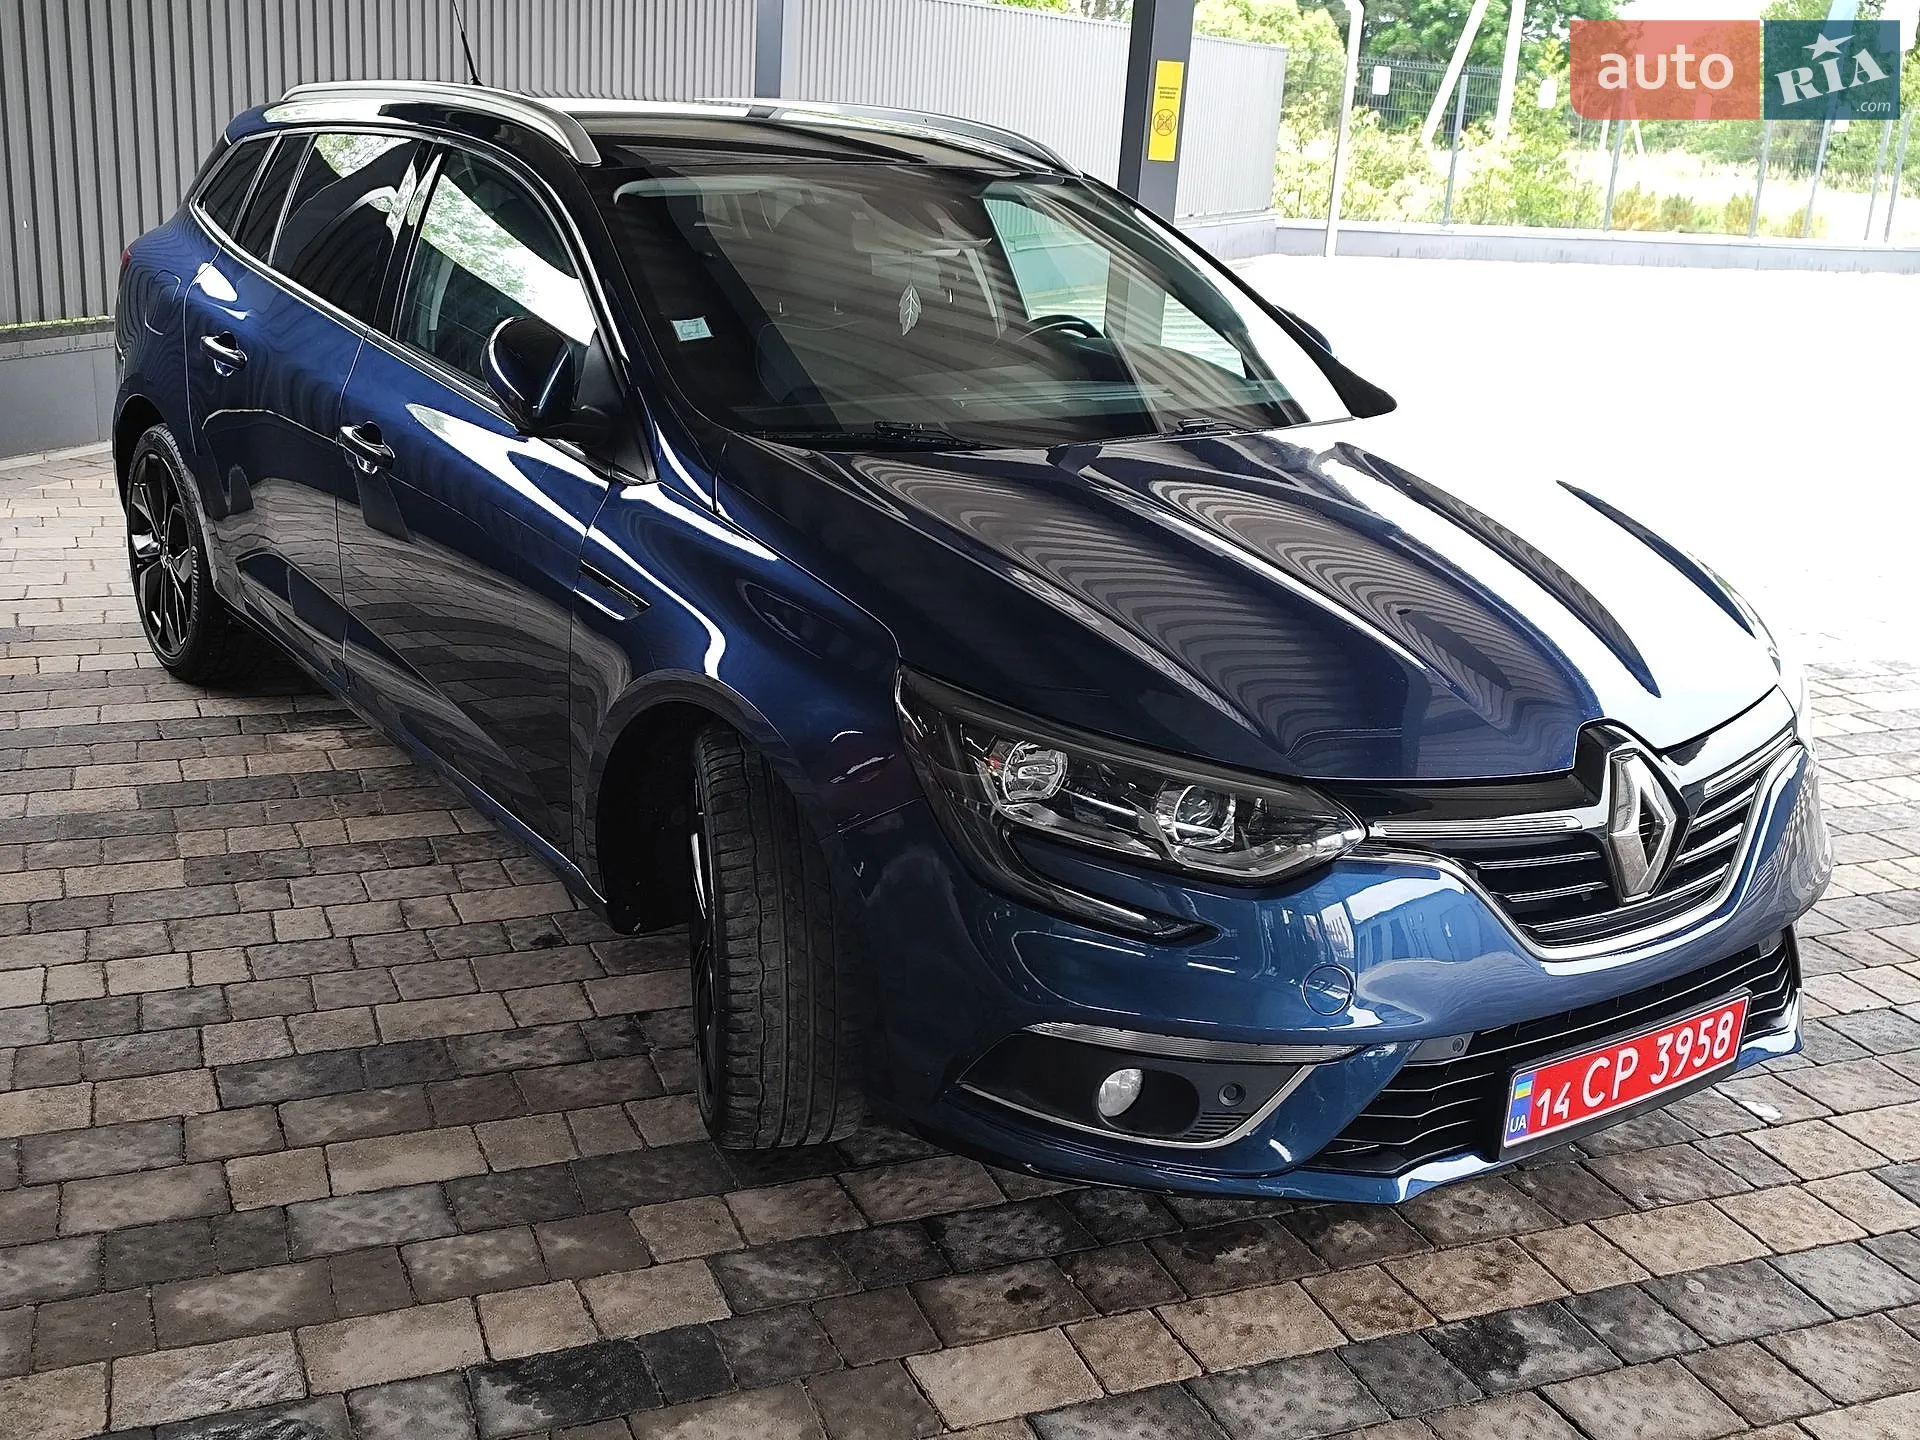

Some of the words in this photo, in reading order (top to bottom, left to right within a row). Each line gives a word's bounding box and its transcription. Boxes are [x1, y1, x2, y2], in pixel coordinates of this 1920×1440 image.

[1536, 1082, 1571, 1127] 14
[1582, 1047, 1639, 1108] CP
[1650, 1010, 1735, 1085] 3958
[1509, 1114, 1527, 1133] UA
